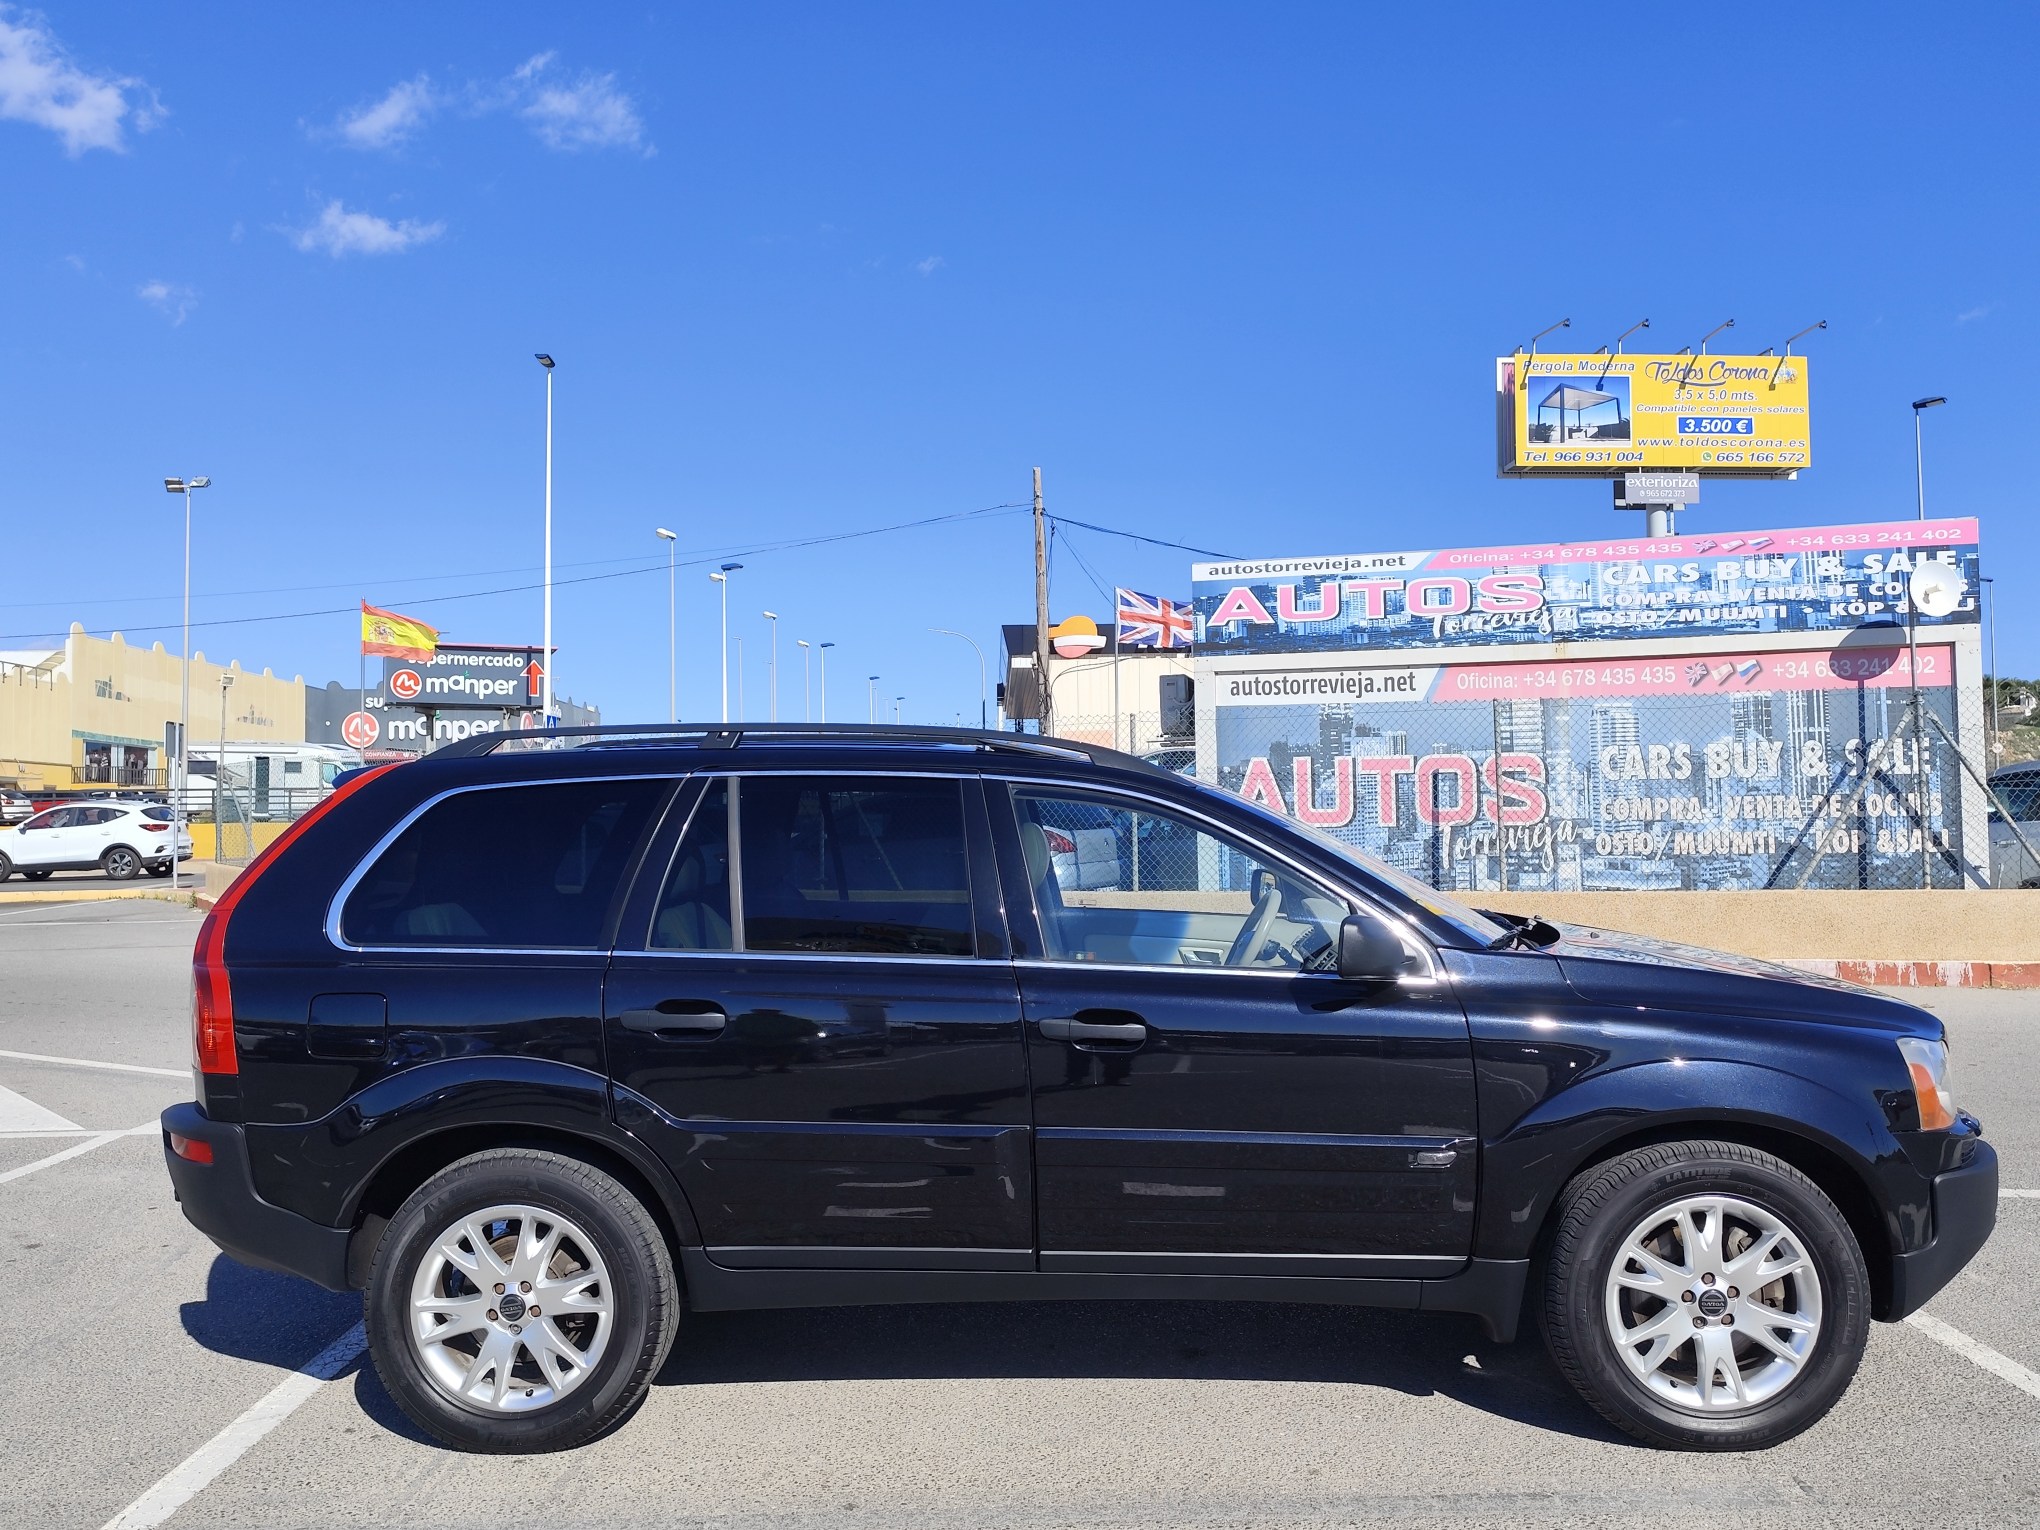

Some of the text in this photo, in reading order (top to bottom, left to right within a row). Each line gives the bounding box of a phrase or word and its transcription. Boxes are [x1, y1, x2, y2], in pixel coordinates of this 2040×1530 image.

[1578, 360, 1635, 371] Moderna
[1712, 361, 1770, 381] Corona
[1674, 390, 1758, 401] 3,5 x 5,0 mts.
[1636, 404, 1697, 413] Compatible
[1722, 405, 1763, 413] paneles
[1766, 405, 1805, 413] solares
[1684, 419, 1749, 433] 3.500 €
[1637, 437, 1806, 447] www.toldoscorona.es
[1524, 452, 1643, 462] Tel. 966 931 004
[1716, 453, 1805, 462] 665 166 572
[1626, 476, 1698, 488] exterioriza
[1785, 528, 1962, 547] +34 633 241 402
[1449, 543, 1683, 563] Oficina: +34 678 435 435
[1208, 555, 1406, 576] autostorrevieja.net
[1602, 562, 1700, 585] CARS
[1716, 557, 1800, 581] BUY
[1815, 556, 1847, 577] &
[1206, 574, 1546, 627] AUTOS
[1601, 577, 1969, 607] COMPRA VENTA DE COS
[1829, 598, 1884, 616] KÖP
[1430, 605, 1578, 639] Torrevieja
[408, 653, 523, 667] permercado
[1773, 660, 1810, 678] +34
[1814, 659, 1851, 677] 633
[1857, 657, 1894, 675] 241
[425, 675, 518, 699] manper
[1229, 671, 1417, 698] autostorrevieja.net
[1456, 666, 1676, 689] Oficina: +34 678 435 435
[1600, 743, 1693, 781] CARS
[1707, 741, 1784, 779] BUY
[1800, 739, 1829, 777] &
[1239, 753, 1547, 828] AUTOS
[1603, 797, 1703, 821] COMPRA
[1726, 795, 1804, 819] VENTA
[1438, 817, 1578, 872] Torrvieja
[1665, 1167, 1732, 1183] LATITUDE
